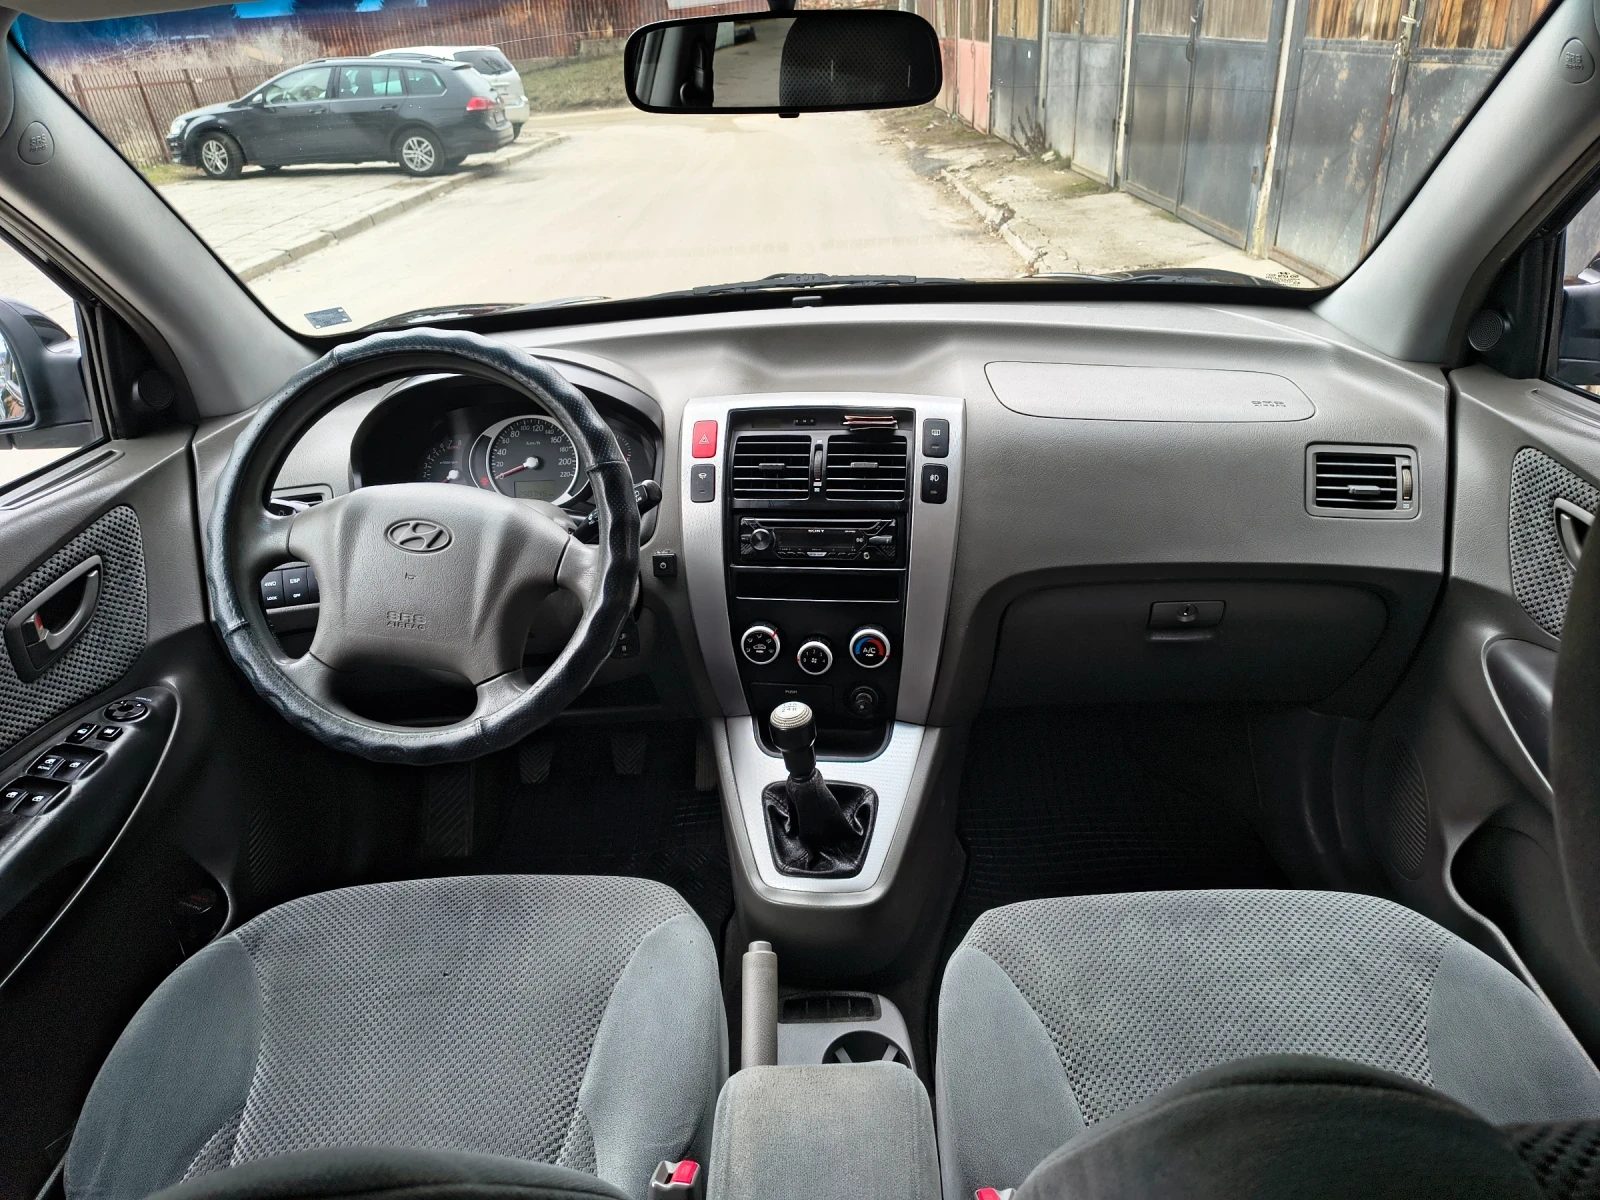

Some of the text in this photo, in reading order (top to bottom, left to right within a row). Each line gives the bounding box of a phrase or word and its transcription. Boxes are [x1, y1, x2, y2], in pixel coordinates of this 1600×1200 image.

[29, 133, 46, 146] SRS
[532, 424, 544, 432] 120
[510, 430, 520, 438] 80
[496, 448, 507, 456] 40
[387, 611, 426, 625] SRS
